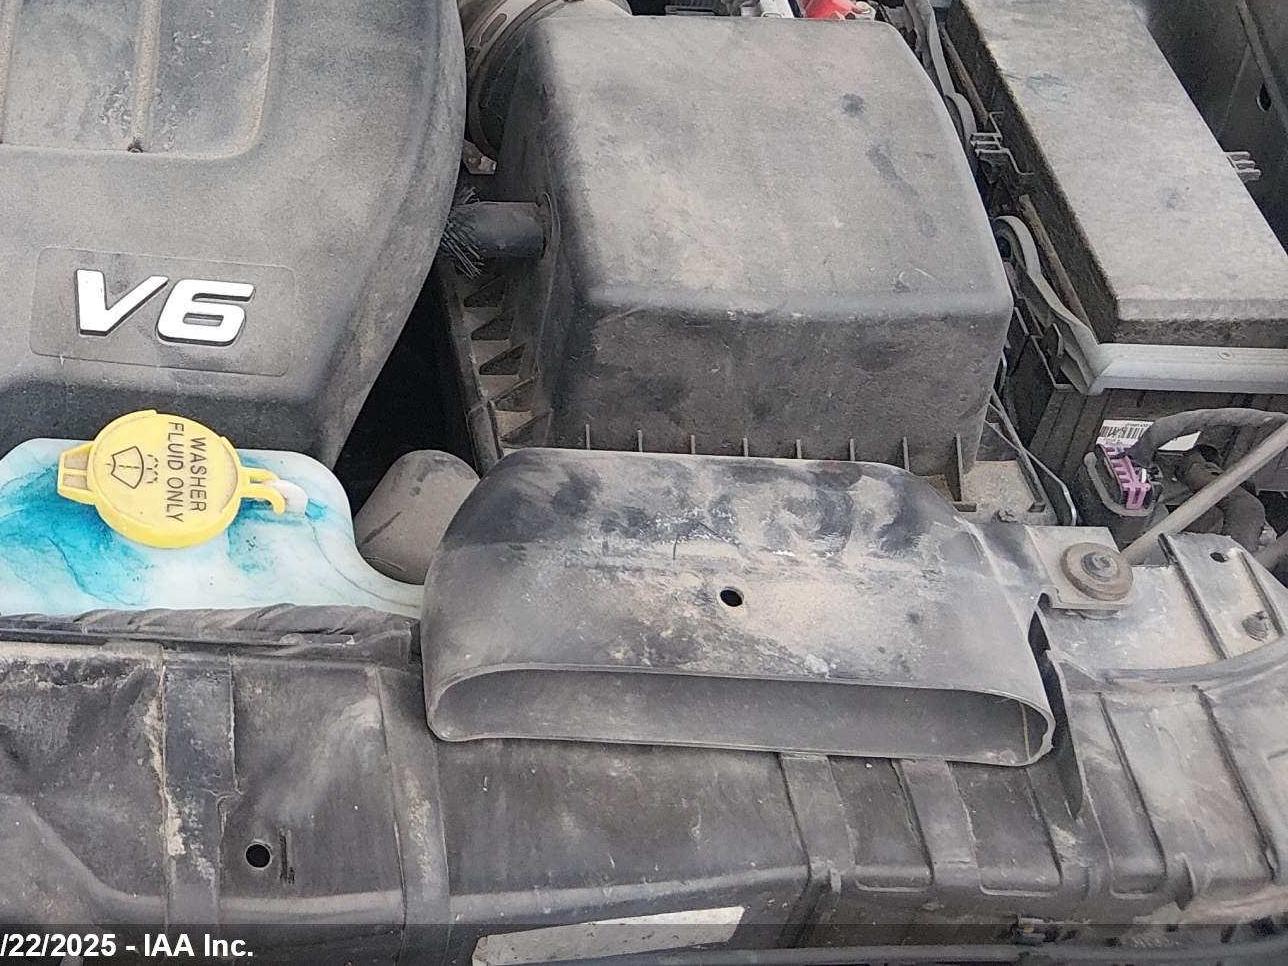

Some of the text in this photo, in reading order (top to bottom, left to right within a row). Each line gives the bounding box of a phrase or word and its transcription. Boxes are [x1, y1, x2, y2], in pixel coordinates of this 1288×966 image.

[75, 269, 255, 346] V6
[165, 421, 185, 523] FLUID ONLY
[189, 436, 207, 513] WASHER
